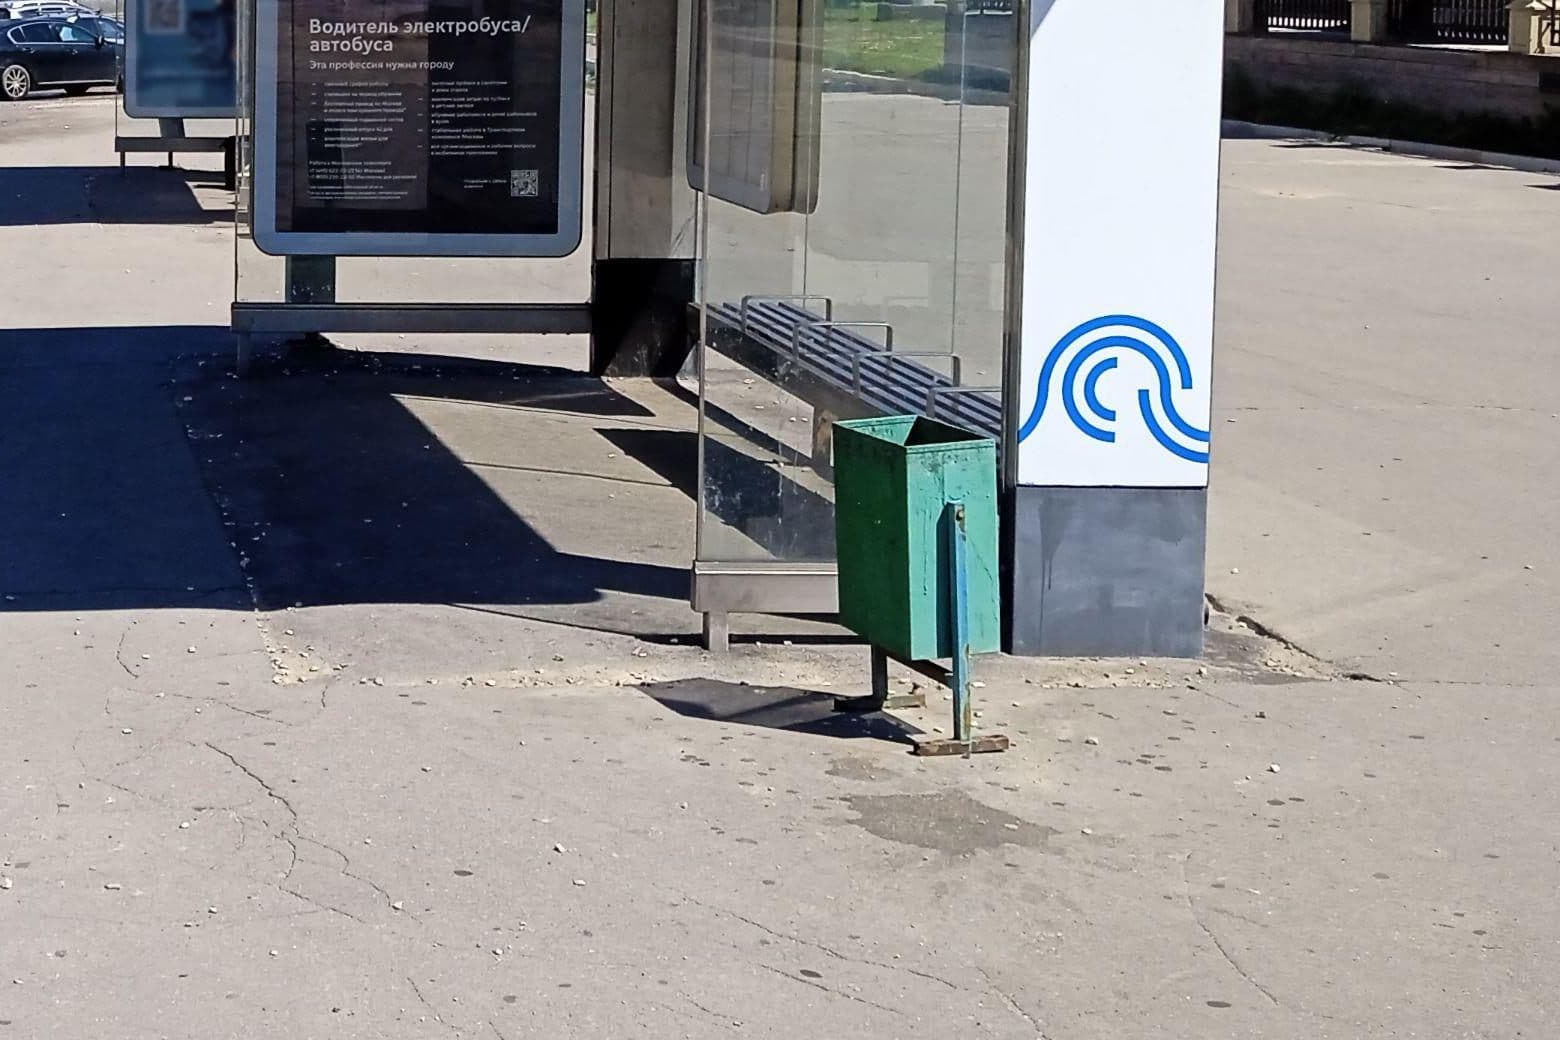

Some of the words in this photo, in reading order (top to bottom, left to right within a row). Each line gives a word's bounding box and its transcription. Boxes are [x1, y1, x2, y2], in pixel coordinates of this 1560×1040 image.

[309, 19, 399, 36] Водитель
[403, 15, 531, 36] электробуса/
[309, 36, 393, 55] автобуса
[309, 61, 328, 70] Эта
[329, 61, 384, 71] профессия
[385, 61, 417, 70] нужна
[419, 61, 455, 71] городу
